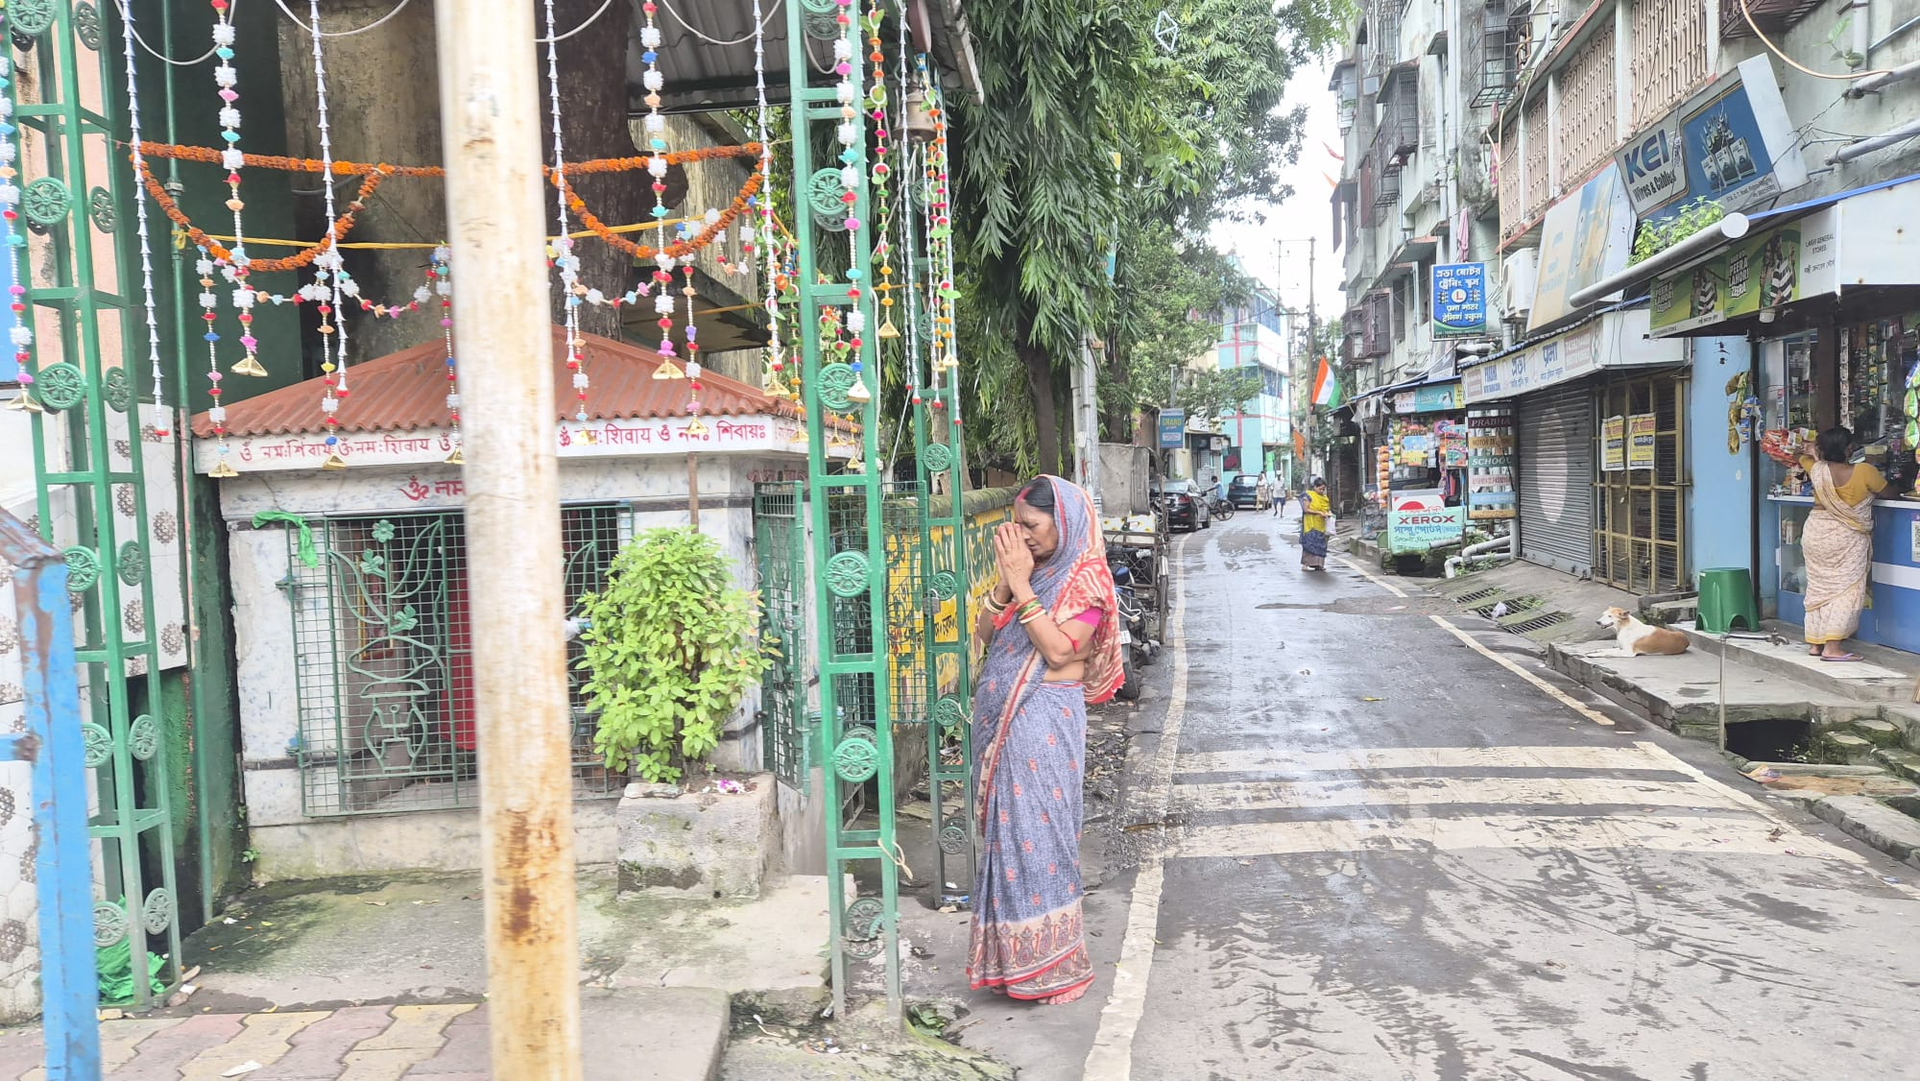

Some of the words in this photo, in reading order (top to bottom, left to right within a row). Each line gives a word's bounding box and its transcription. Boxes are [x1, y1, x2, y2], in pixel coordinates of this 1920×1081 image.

[1624, 128, 1670, 184] KEI
[1633, 181, 1652, 203] Wires
[1655, 168, 1676, 193] Cables
[1456, 291, 1463, 300] L
[1471, 417, 1512, 428] PRABHA
[1472, 456, 1513, 466] SCHOOL
[1398, 514, 1456, 525] XEROX
